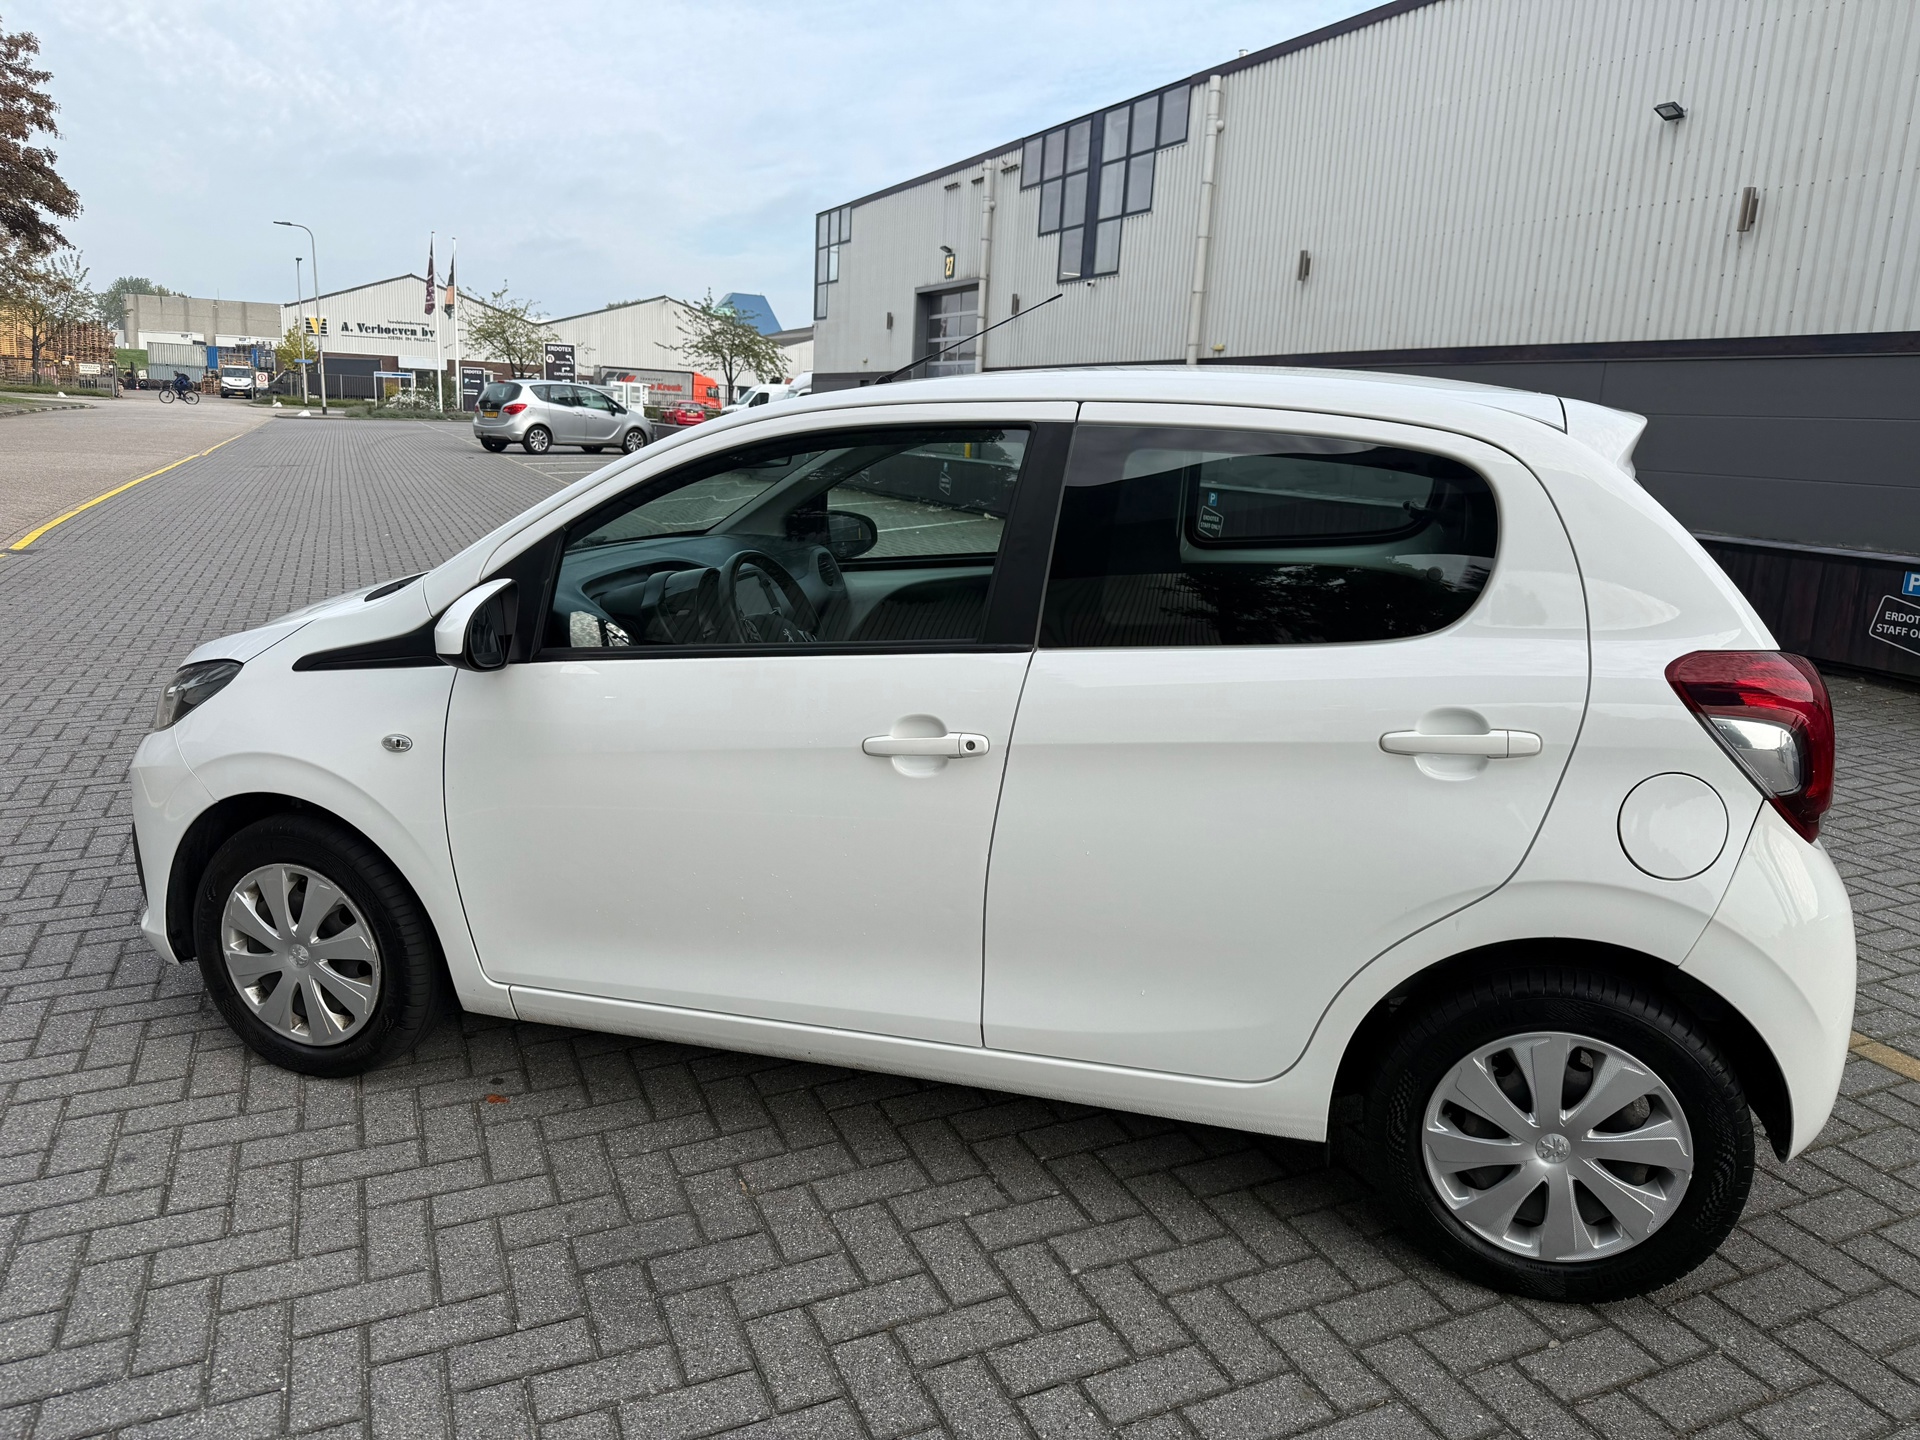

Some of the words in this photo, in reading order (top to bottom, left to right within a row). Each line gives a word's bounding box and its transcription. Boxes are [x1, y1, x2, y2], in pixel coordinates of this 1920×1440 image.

[946, 256, 954, 276] 27
[341, 322, 353, 332] A.
[357, 323, 417, 336] Verhoeven
[1210, 493, 1216, 504] P
[1876, 623, 1908, 636] STAFF
[1909, 628, 1920, 639] O
